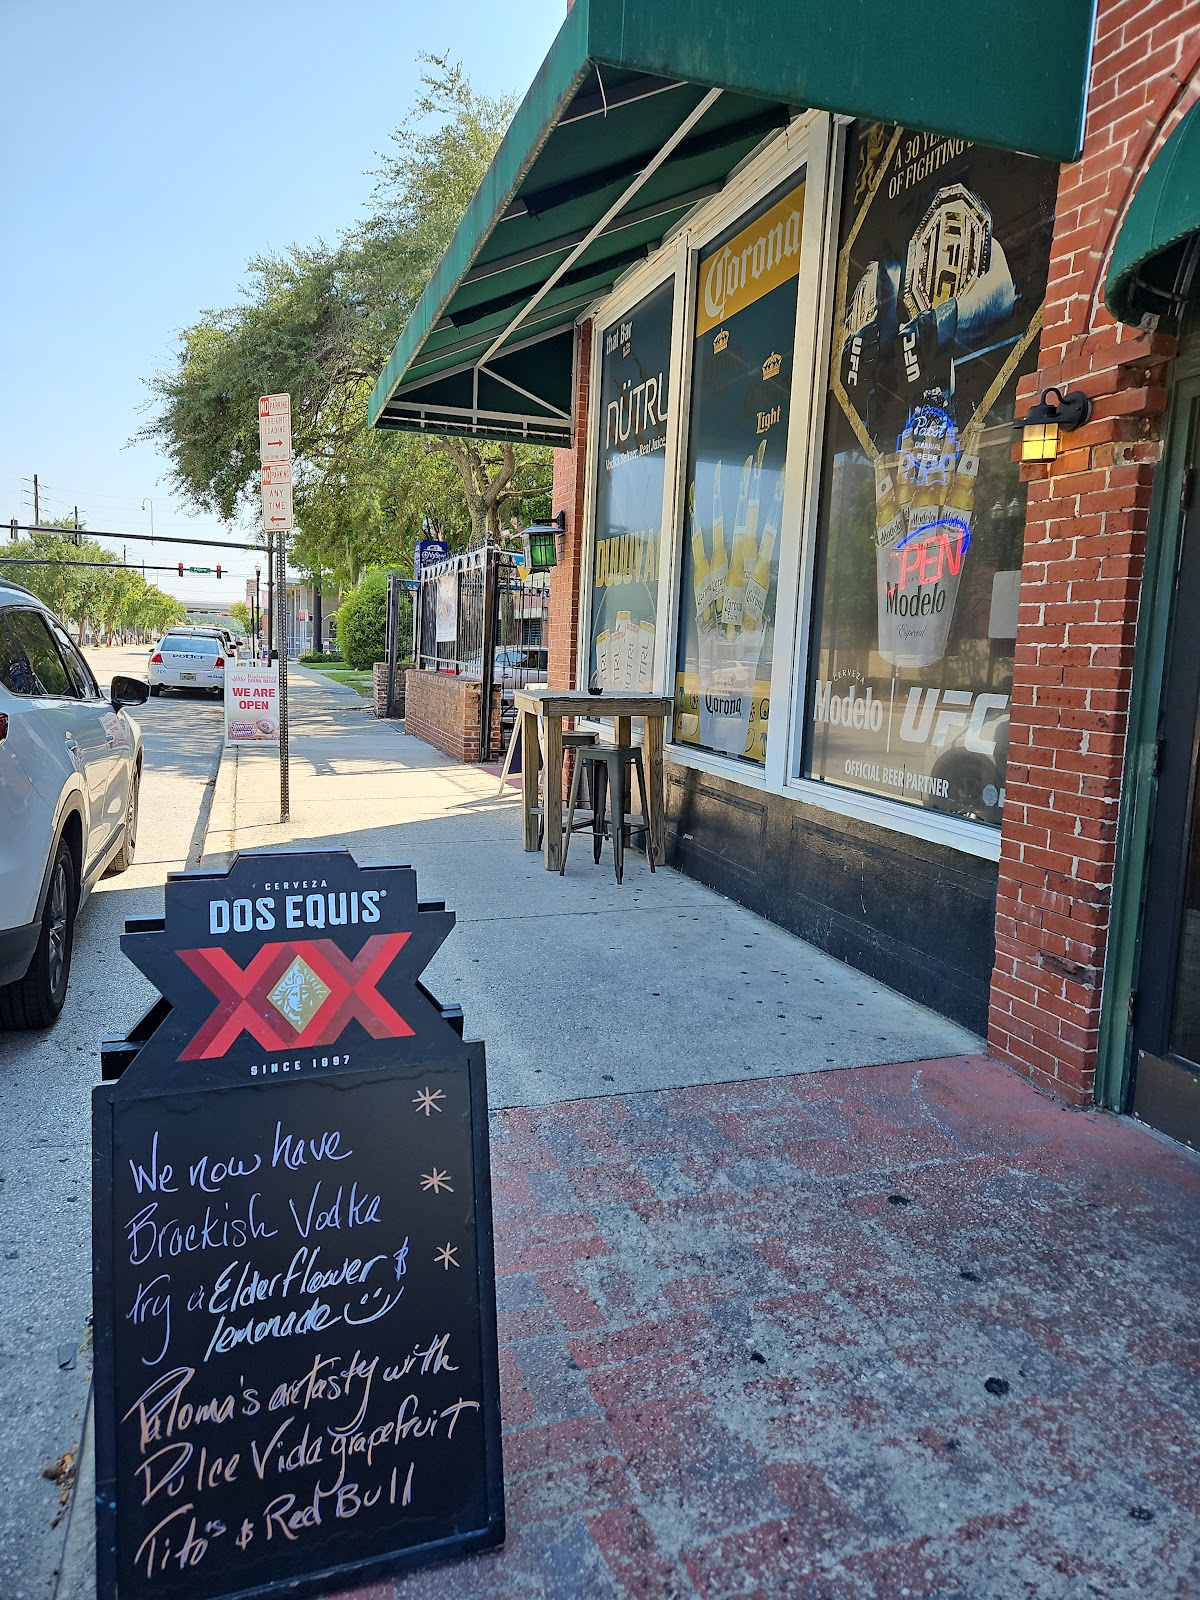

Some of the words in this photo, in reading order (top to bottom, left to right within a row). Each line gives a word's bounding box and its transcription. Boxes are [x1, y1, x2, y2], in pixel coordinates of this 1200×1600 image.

[893, 147, 902, 171] A
[905, 135, 920, 164] 30
[923, 132, 945, 151] YE
[888, 171, 904, 199] OF
[905, 138, 964, 190] FIGHTING
[704, 210, 801, 319] Corona
[620, 320, 633, 345] Bar
[847, 336, 863, 387] UFC
[902, 332, 921, 383] UFC
[261, 400, 269, 414] NO
[269, 400, 288, 411] PARKING
[264, 416, 285, 426] FREIGHT
[756, 404, 782, 434] Light
[264, 426, 286, 435] LOADING
[913, 415, 947, 440] Pabst
[916, 452, 939, 462] BEER
[262, 469, 271, 482] NO
[271, 469, 290, 480] PARKING
[268, 501, 286, 511] TIME
[269, 488, 284, 498] ANY
[886, 581, 946, 617] Modelo
[232, 687, 251, 697] WE
[252, 688, 276, 698] ARE
[832, 668, 866, 685] CERVEZA
[238, 700, 269, 710] OPEN
[704, 687, 742, 718] Corona
[813, 679, 884, 733] Modelo
[900, 686, 1010, 756] UFC
[844, 758, 881, 783] OFFICIAL
[882, 766, 905, 788] BEER
[905, 771, 950, 799] PARTNER
[264, 879, 328, 891] CERVEZA
[209, 896, 277, 934] DOS
[250, 1059, 302, 1076] SINCE
[311, 1054, 352, 1070] 1897
[128, 1130, 180, 1194] We
[188, 1152, 262, 1193] now
[270, 1120, 354, 1171] have
[123, 1192, 280, 1266] Brackish
[288, 1180, 382, 1239] Vodka
[208, 1245, 388, 1314] Elderflower
[203, 1297, 342, 1363] lemonade
[121, 1366, 262, 1455] Paloma's
[382, 1332, 460, 1382] with
[133, 1441, 241, 1506] Dulce
[250, 1415, 323, 1480] Vida
[262, 1479, 323, 1541] Red
[335, 1461, 416, 1520] Bull
